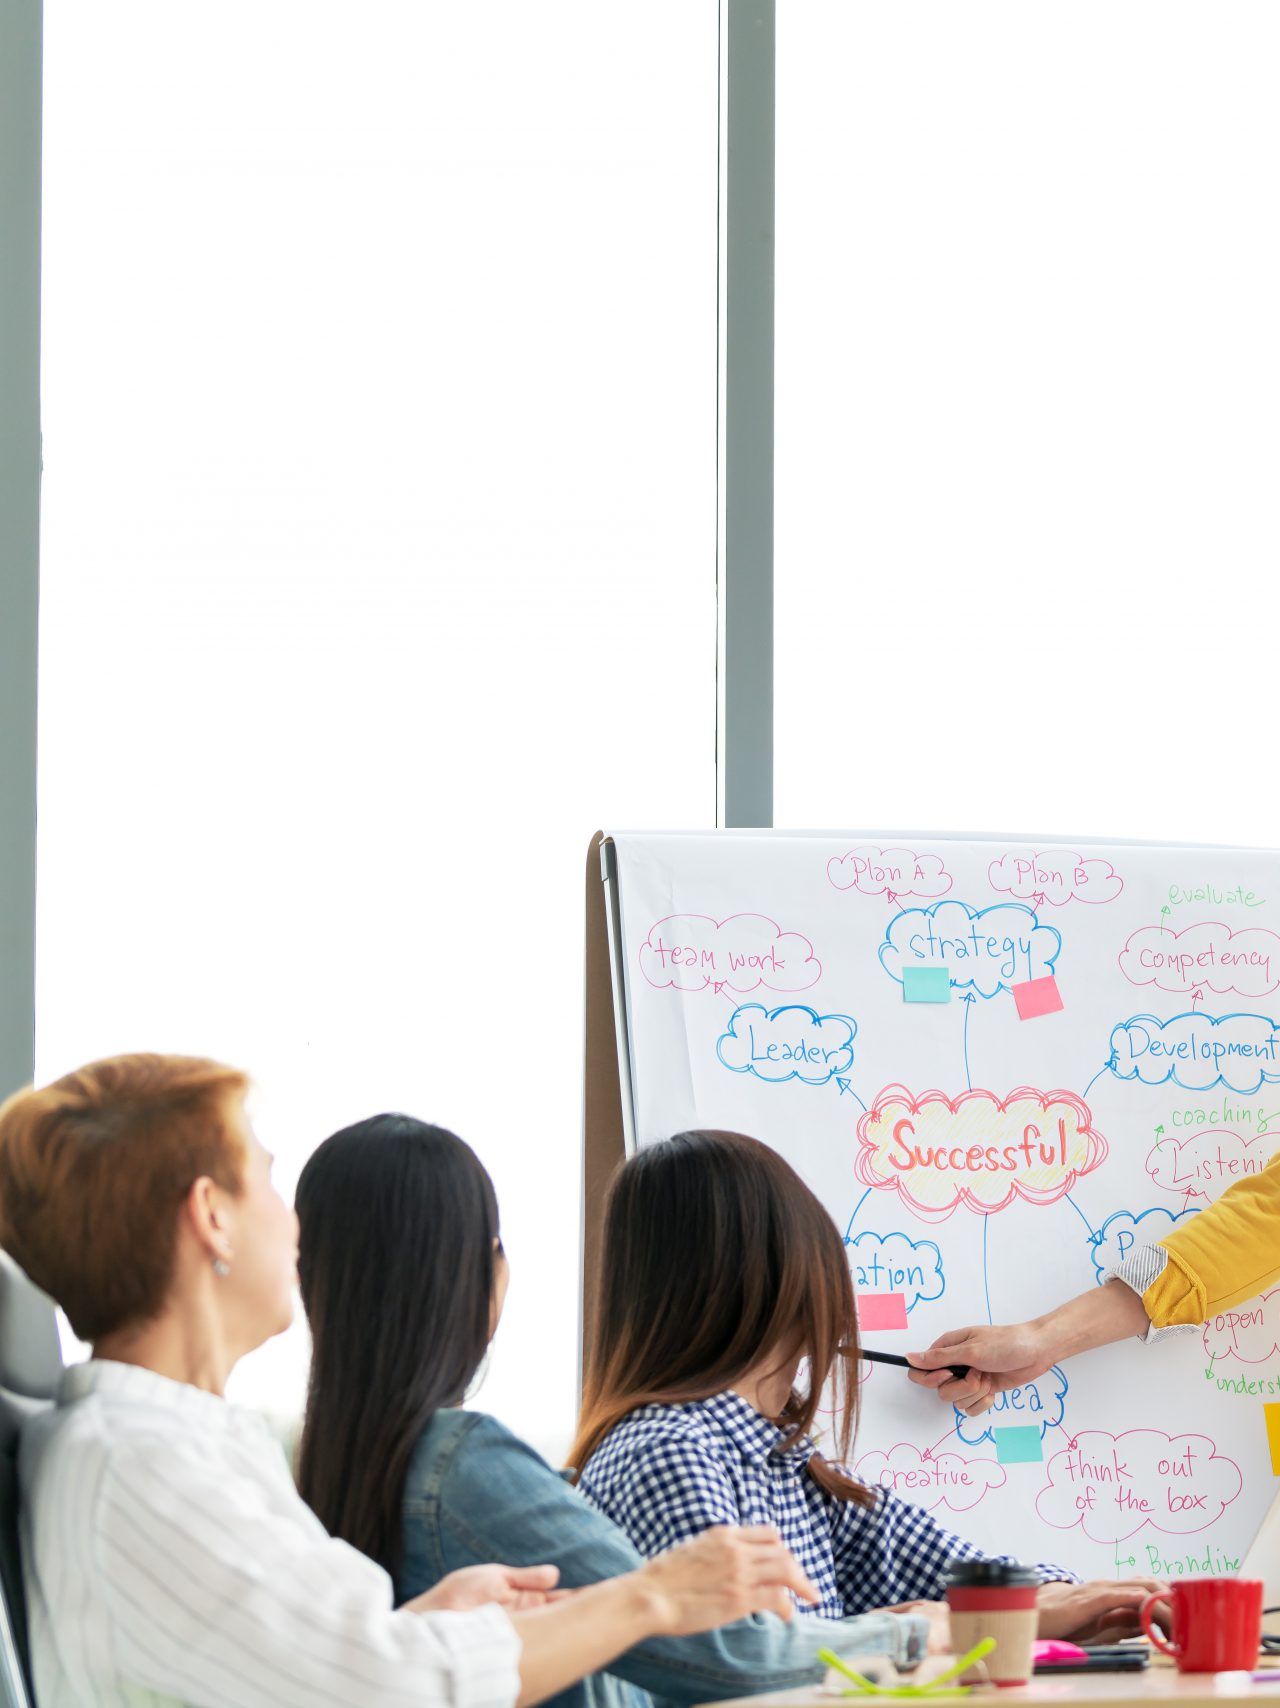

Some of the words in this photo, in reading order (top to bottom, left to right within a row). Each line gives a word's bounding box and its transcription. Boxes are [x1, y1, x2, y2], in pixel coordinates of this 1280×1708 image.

[851, 857, 902, 883] Plan
[913, 863, 926, 881] A
[1013, 854, 1063, 885] Plan
[1074, 867, 1089, 886] B
[1168, 883, 1266, 907] evaluate
[728, 945, 786, 973] work
[750, 1025, 838, 1064] Leader
[1128, 1032, 1280, 1072] Development
[887, 1116, 1068, 1172] Successful
[1173, 1146, 1270, 1184] Listeni
[850, 1252, 925, 1292] ation
[1065, 1449, 1134, 1483] think
[1158, 1446, 1198, 1478] out
[1075, 1487, 1097, 1511] of
[1114, 1489, 1155, 1513] the
[1167, 1487, 1209, 1513] box
